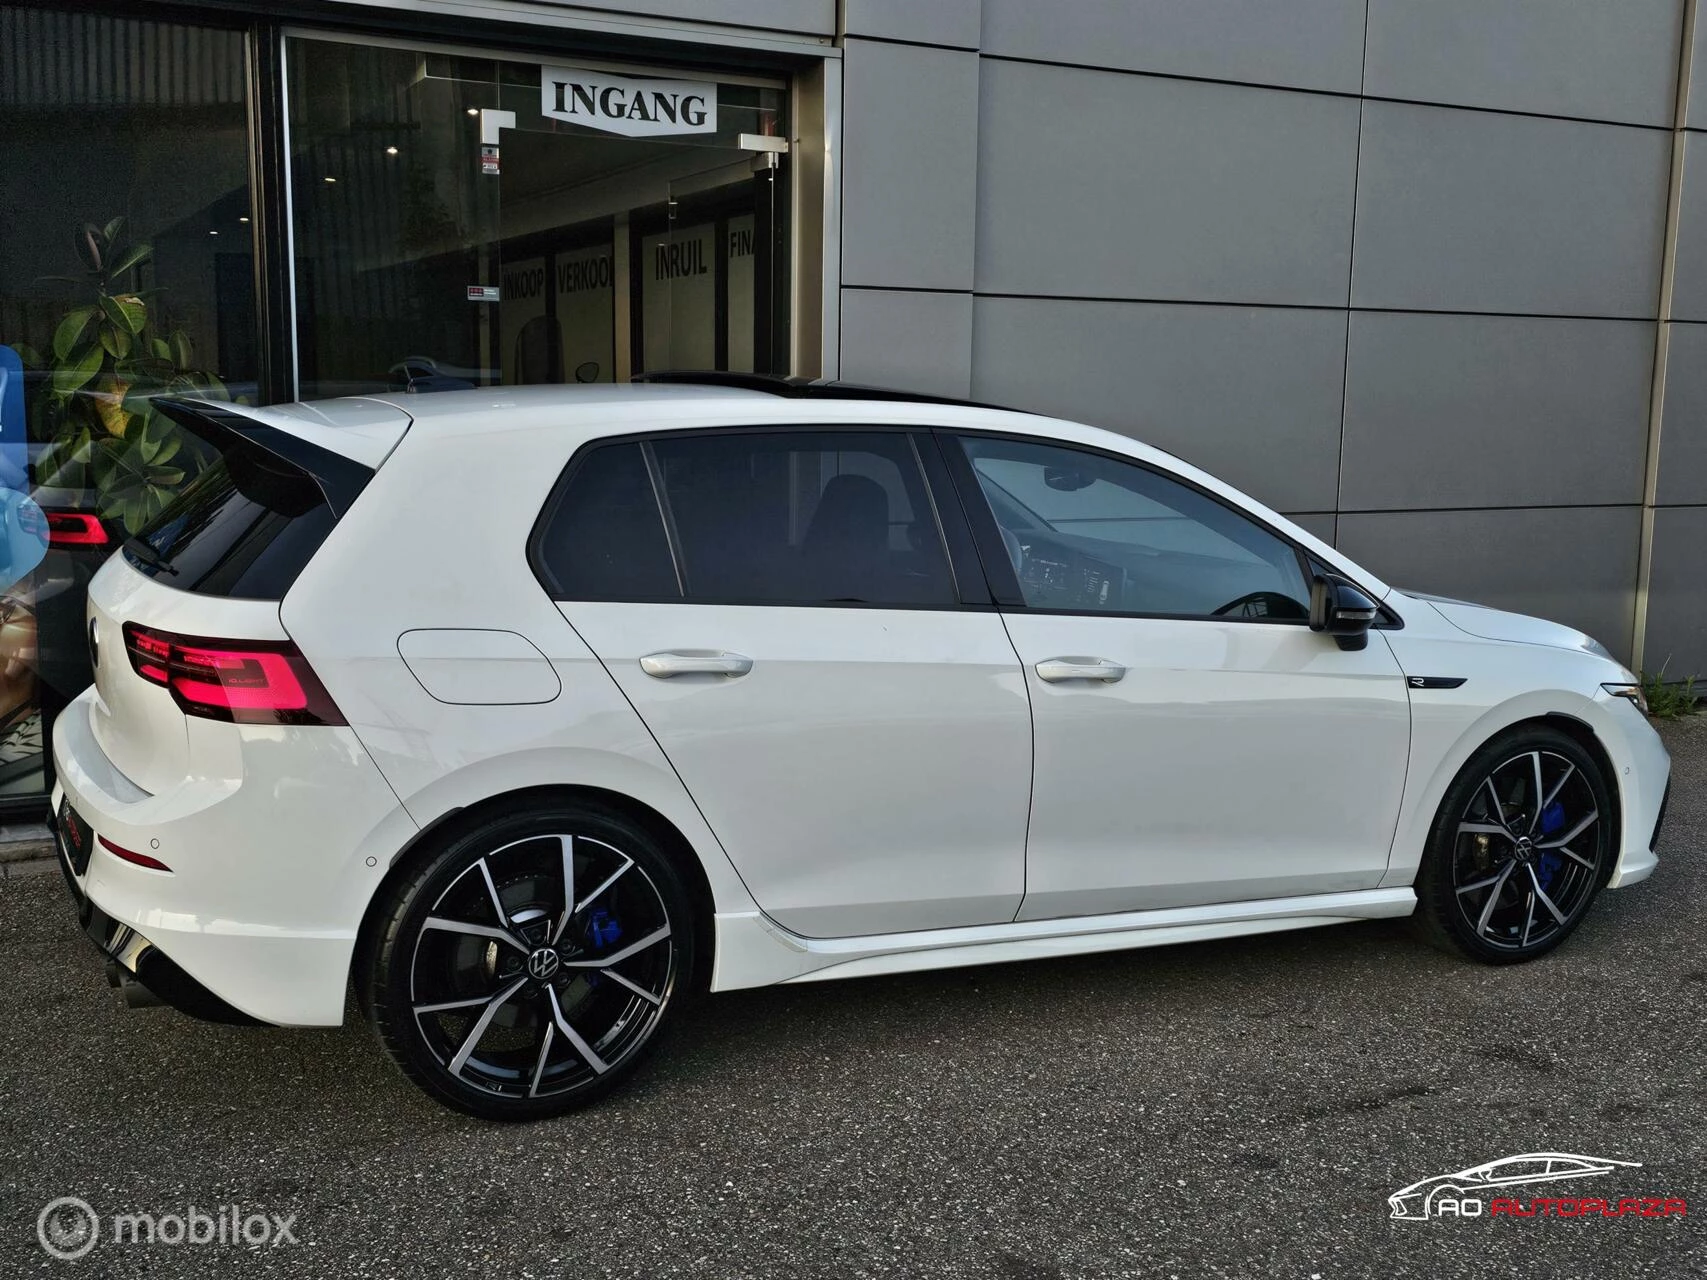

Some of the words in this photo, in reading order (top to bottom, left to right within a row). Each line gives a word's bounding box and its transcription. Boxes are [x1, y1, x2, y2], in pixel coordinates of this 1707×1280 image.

[552, 81, 707, 126] INGANG
[655, 238, 707, 280] INRUIL
[504, 268, 544, 300] INKOOP
